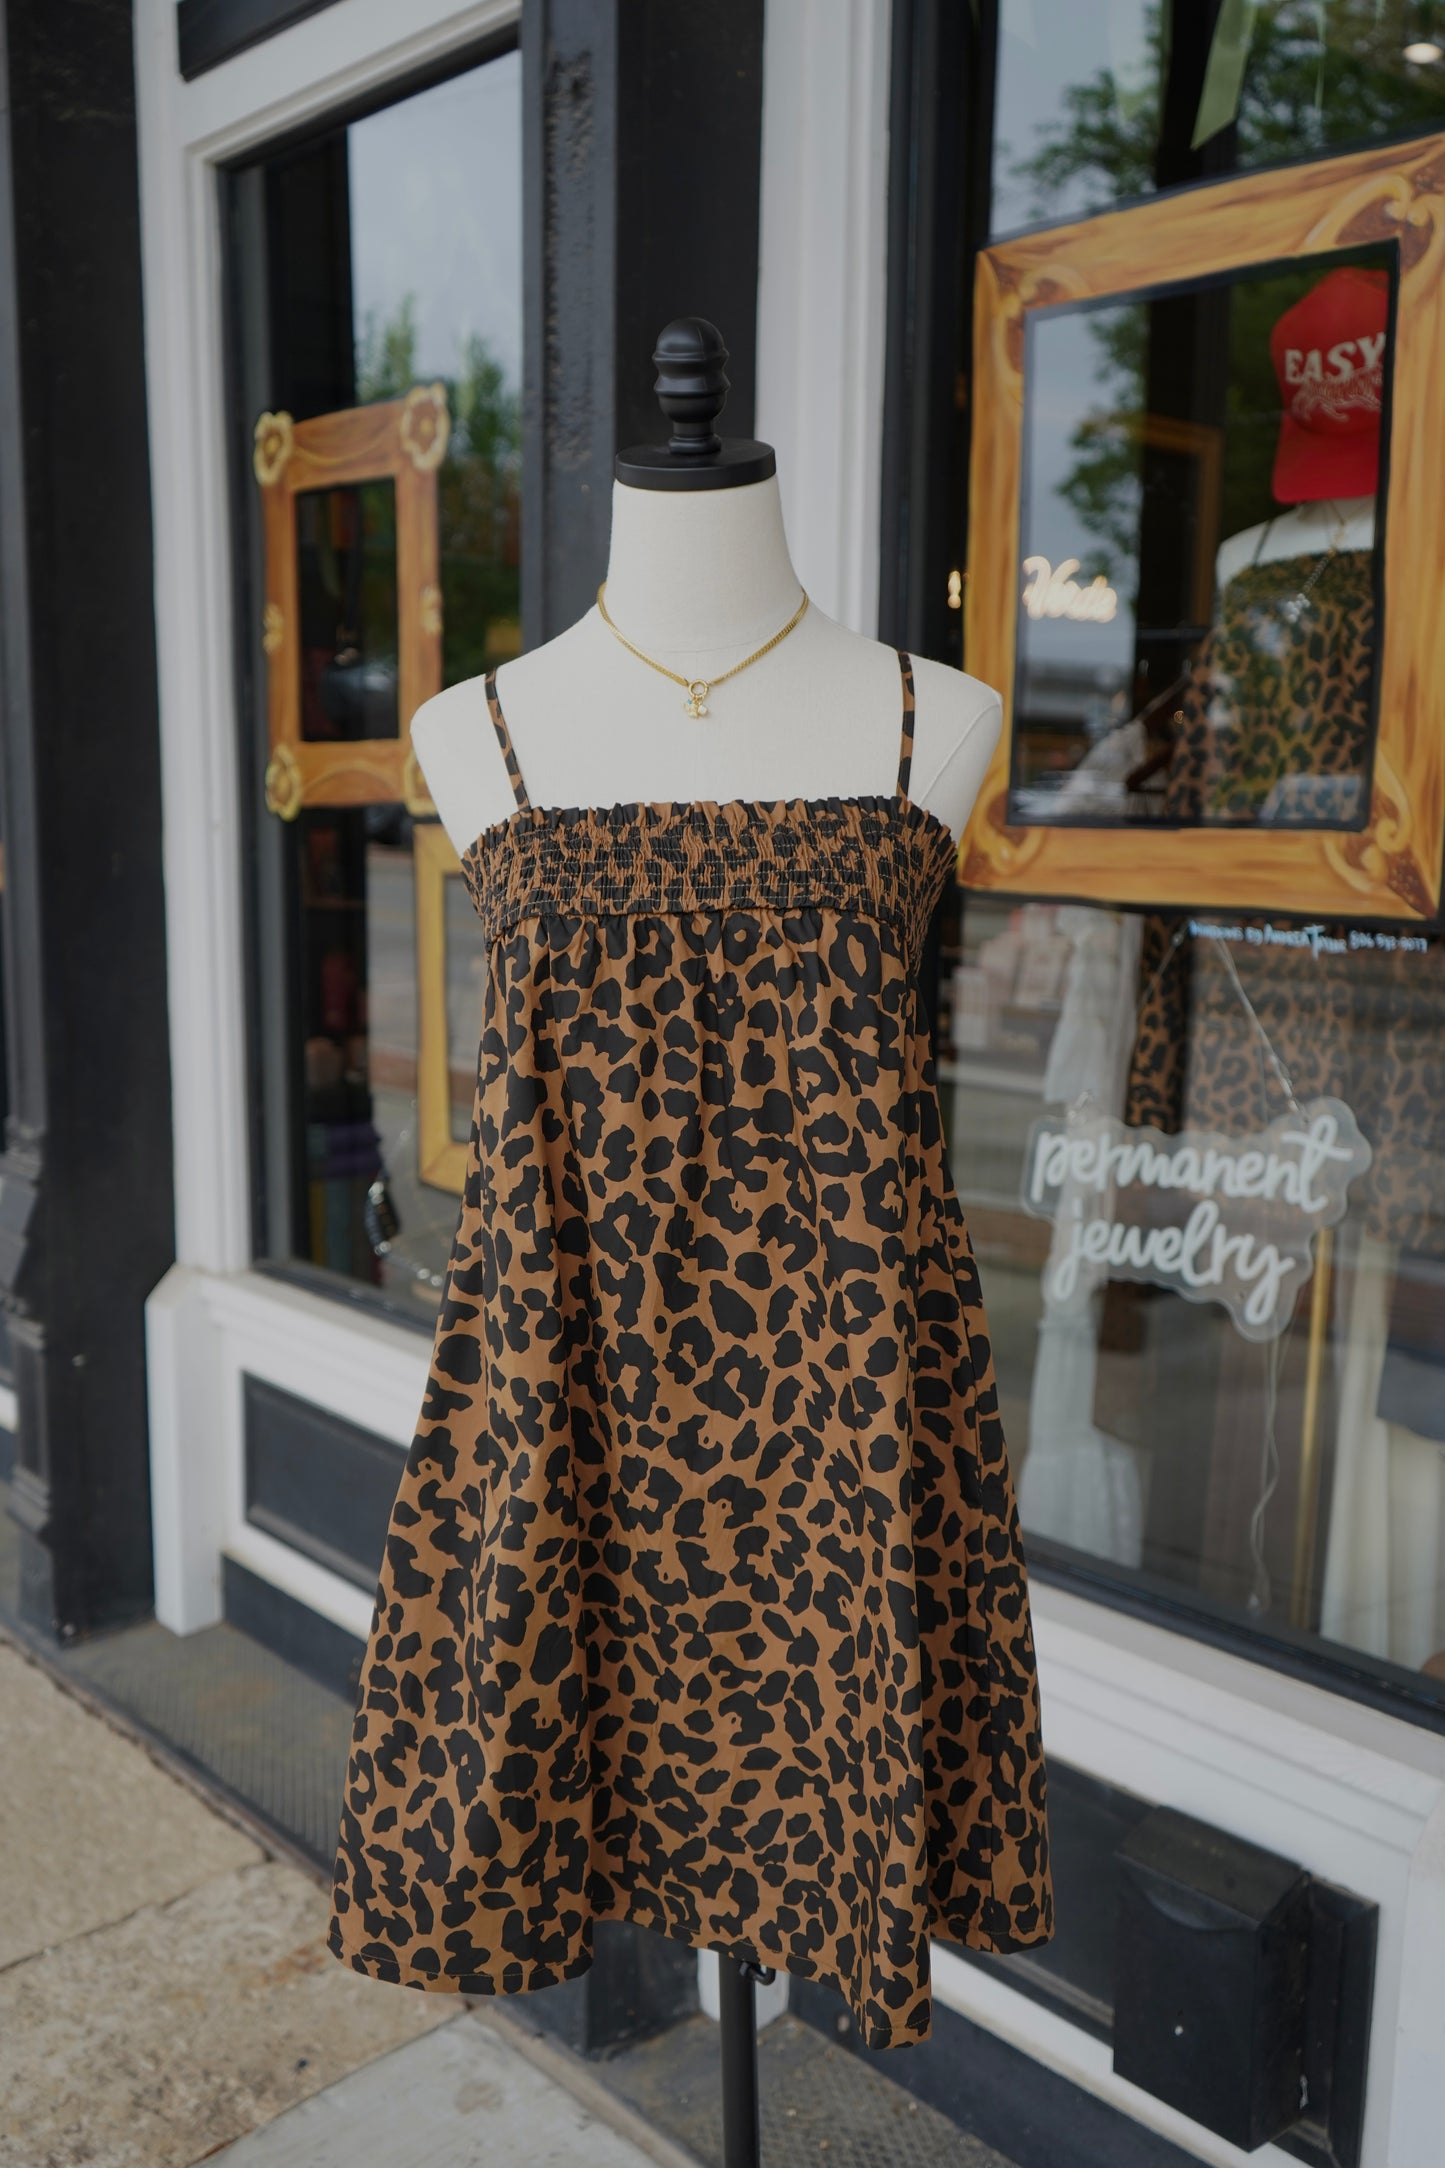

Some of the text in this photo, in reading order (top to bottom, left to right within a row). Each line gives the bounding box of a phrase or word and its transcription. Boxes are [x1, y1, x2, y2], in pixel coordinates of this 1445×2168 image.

[1285, 331, 1386, 384] EASY
[1030, 1115, 1354, 1213] permanent
[1051, 1198, 1296, 1326] jewelry
